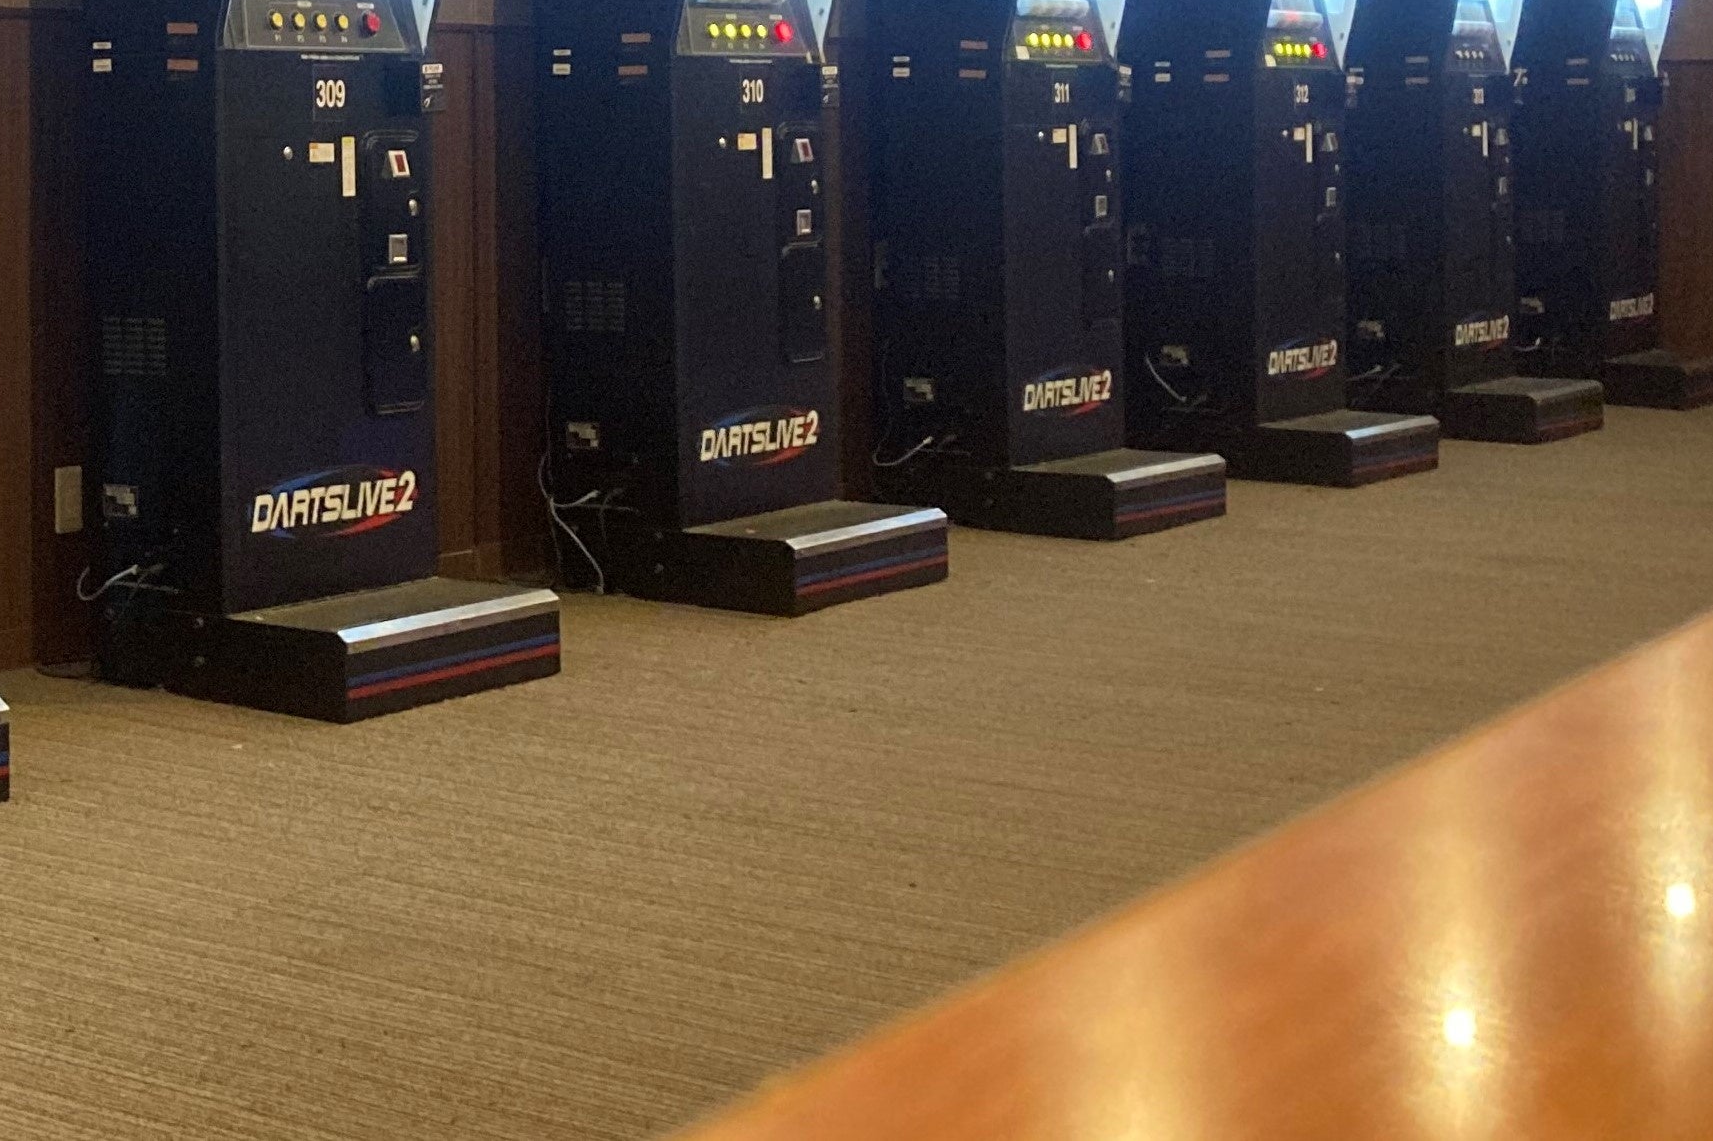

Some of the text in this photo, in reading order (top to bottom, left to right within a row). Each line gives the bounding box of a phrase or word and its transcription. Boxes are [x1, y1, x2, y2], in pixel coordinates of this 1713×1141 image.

[315, 79, 346, 108] 309
[742, 79, 764, 103] 310
[1054, 83, 1070, 103] 311
[1268, 339, 1337, 375] DARTSLIVE2
[1023, 369, 1112, 411] DARTSLIVE2
[700, 410, 819, 462] DARTSLIVE2
[252, 470, 416, 533] DARTSLIVE2
